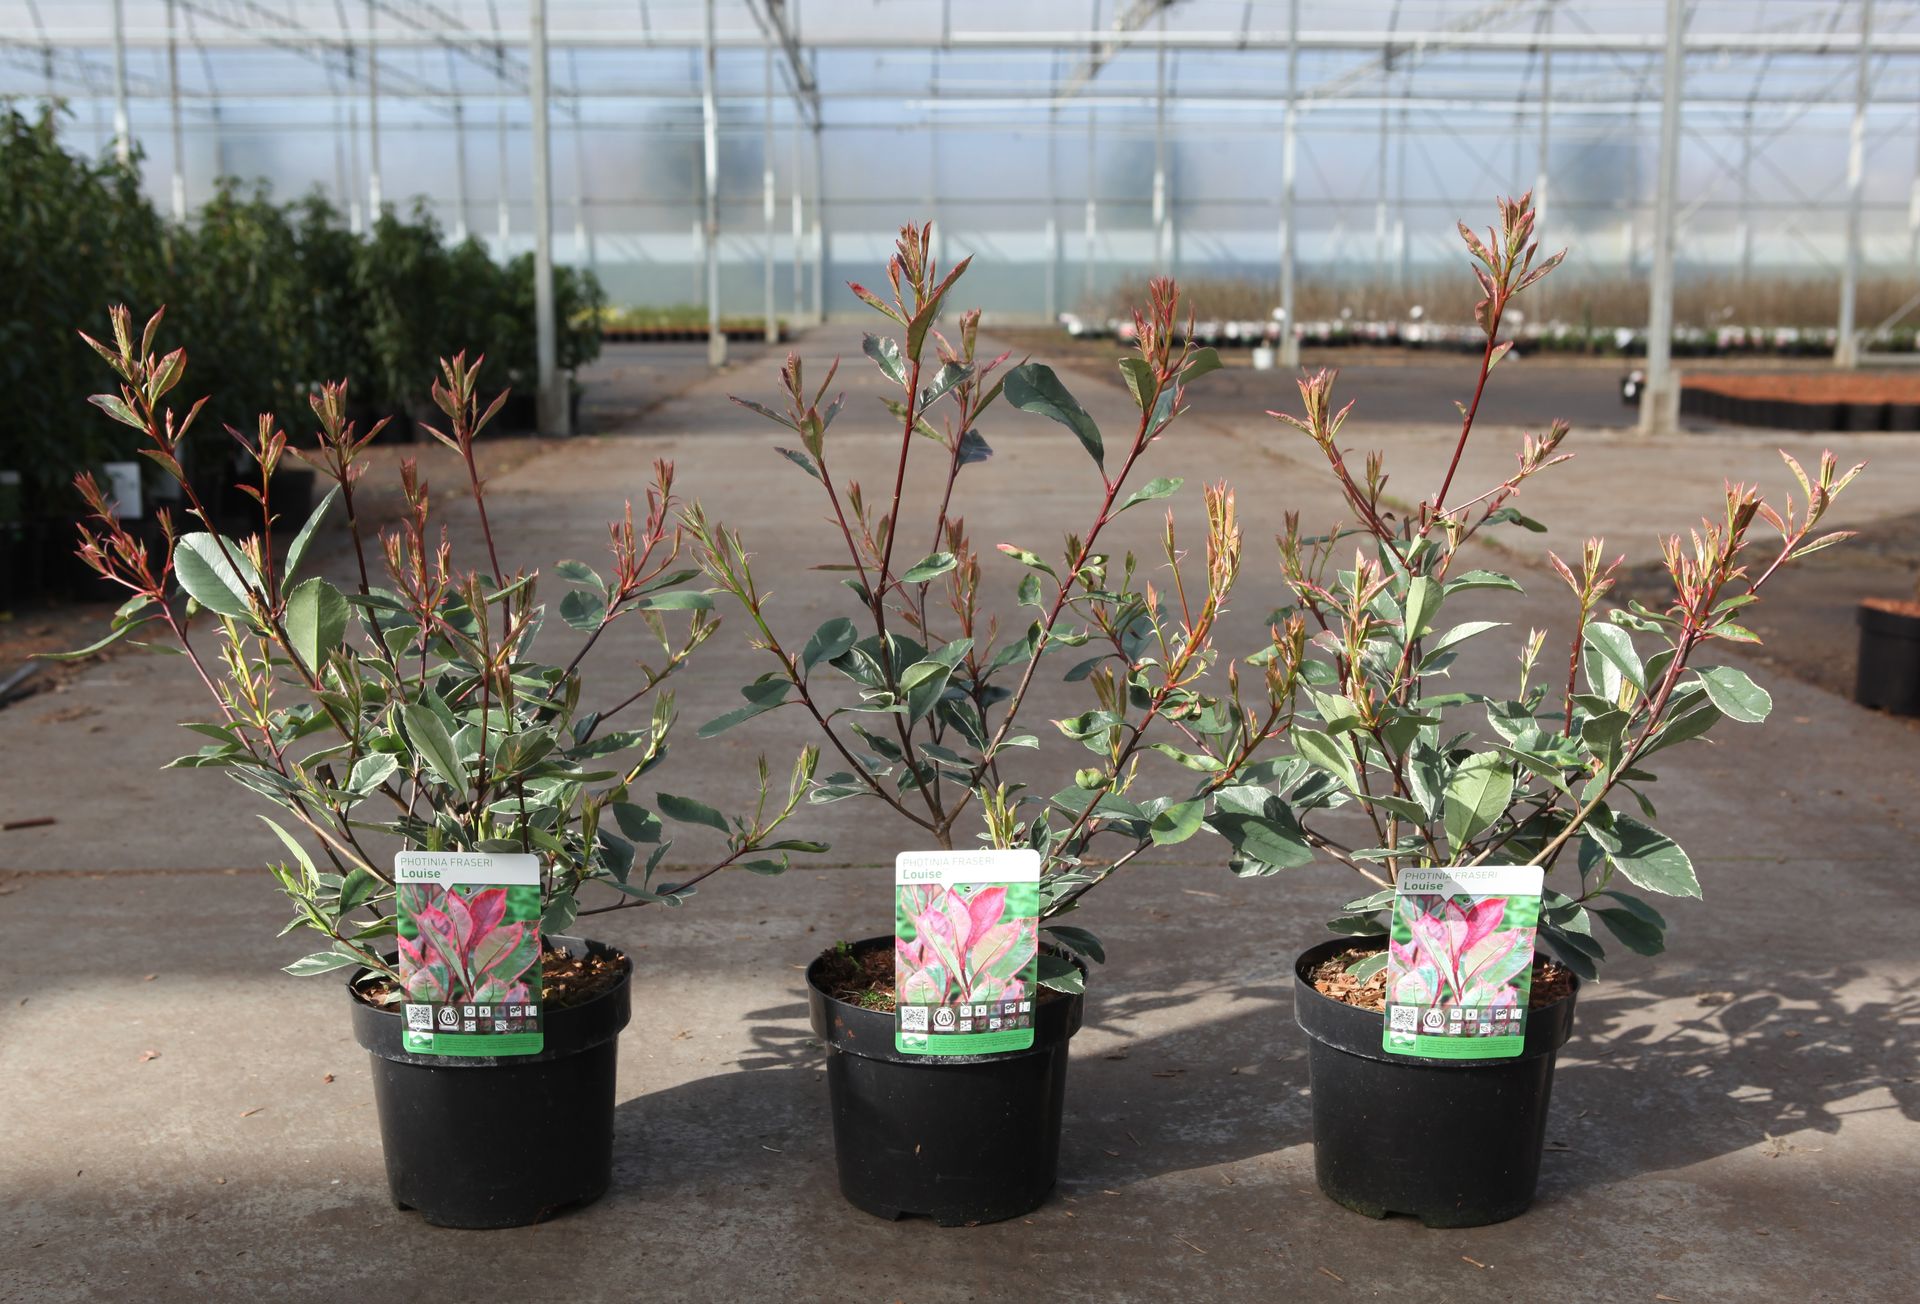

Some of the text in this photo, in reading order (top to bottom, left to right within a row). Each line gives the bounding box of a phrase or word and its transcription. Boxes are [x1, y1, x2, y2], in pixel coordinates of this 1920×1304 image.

[401, 857, 493, 867] PHOTINIA FRASERI
[903, 856, 995, 867] PHOTINIA FRASERI
[401, 868, 441, 879] Louise
[903, 869, 942, 880] Louise
[1405, 871, 1498, 880] PHOTINIA FRASERI
[1404, 881, 1443, 891] Louise
